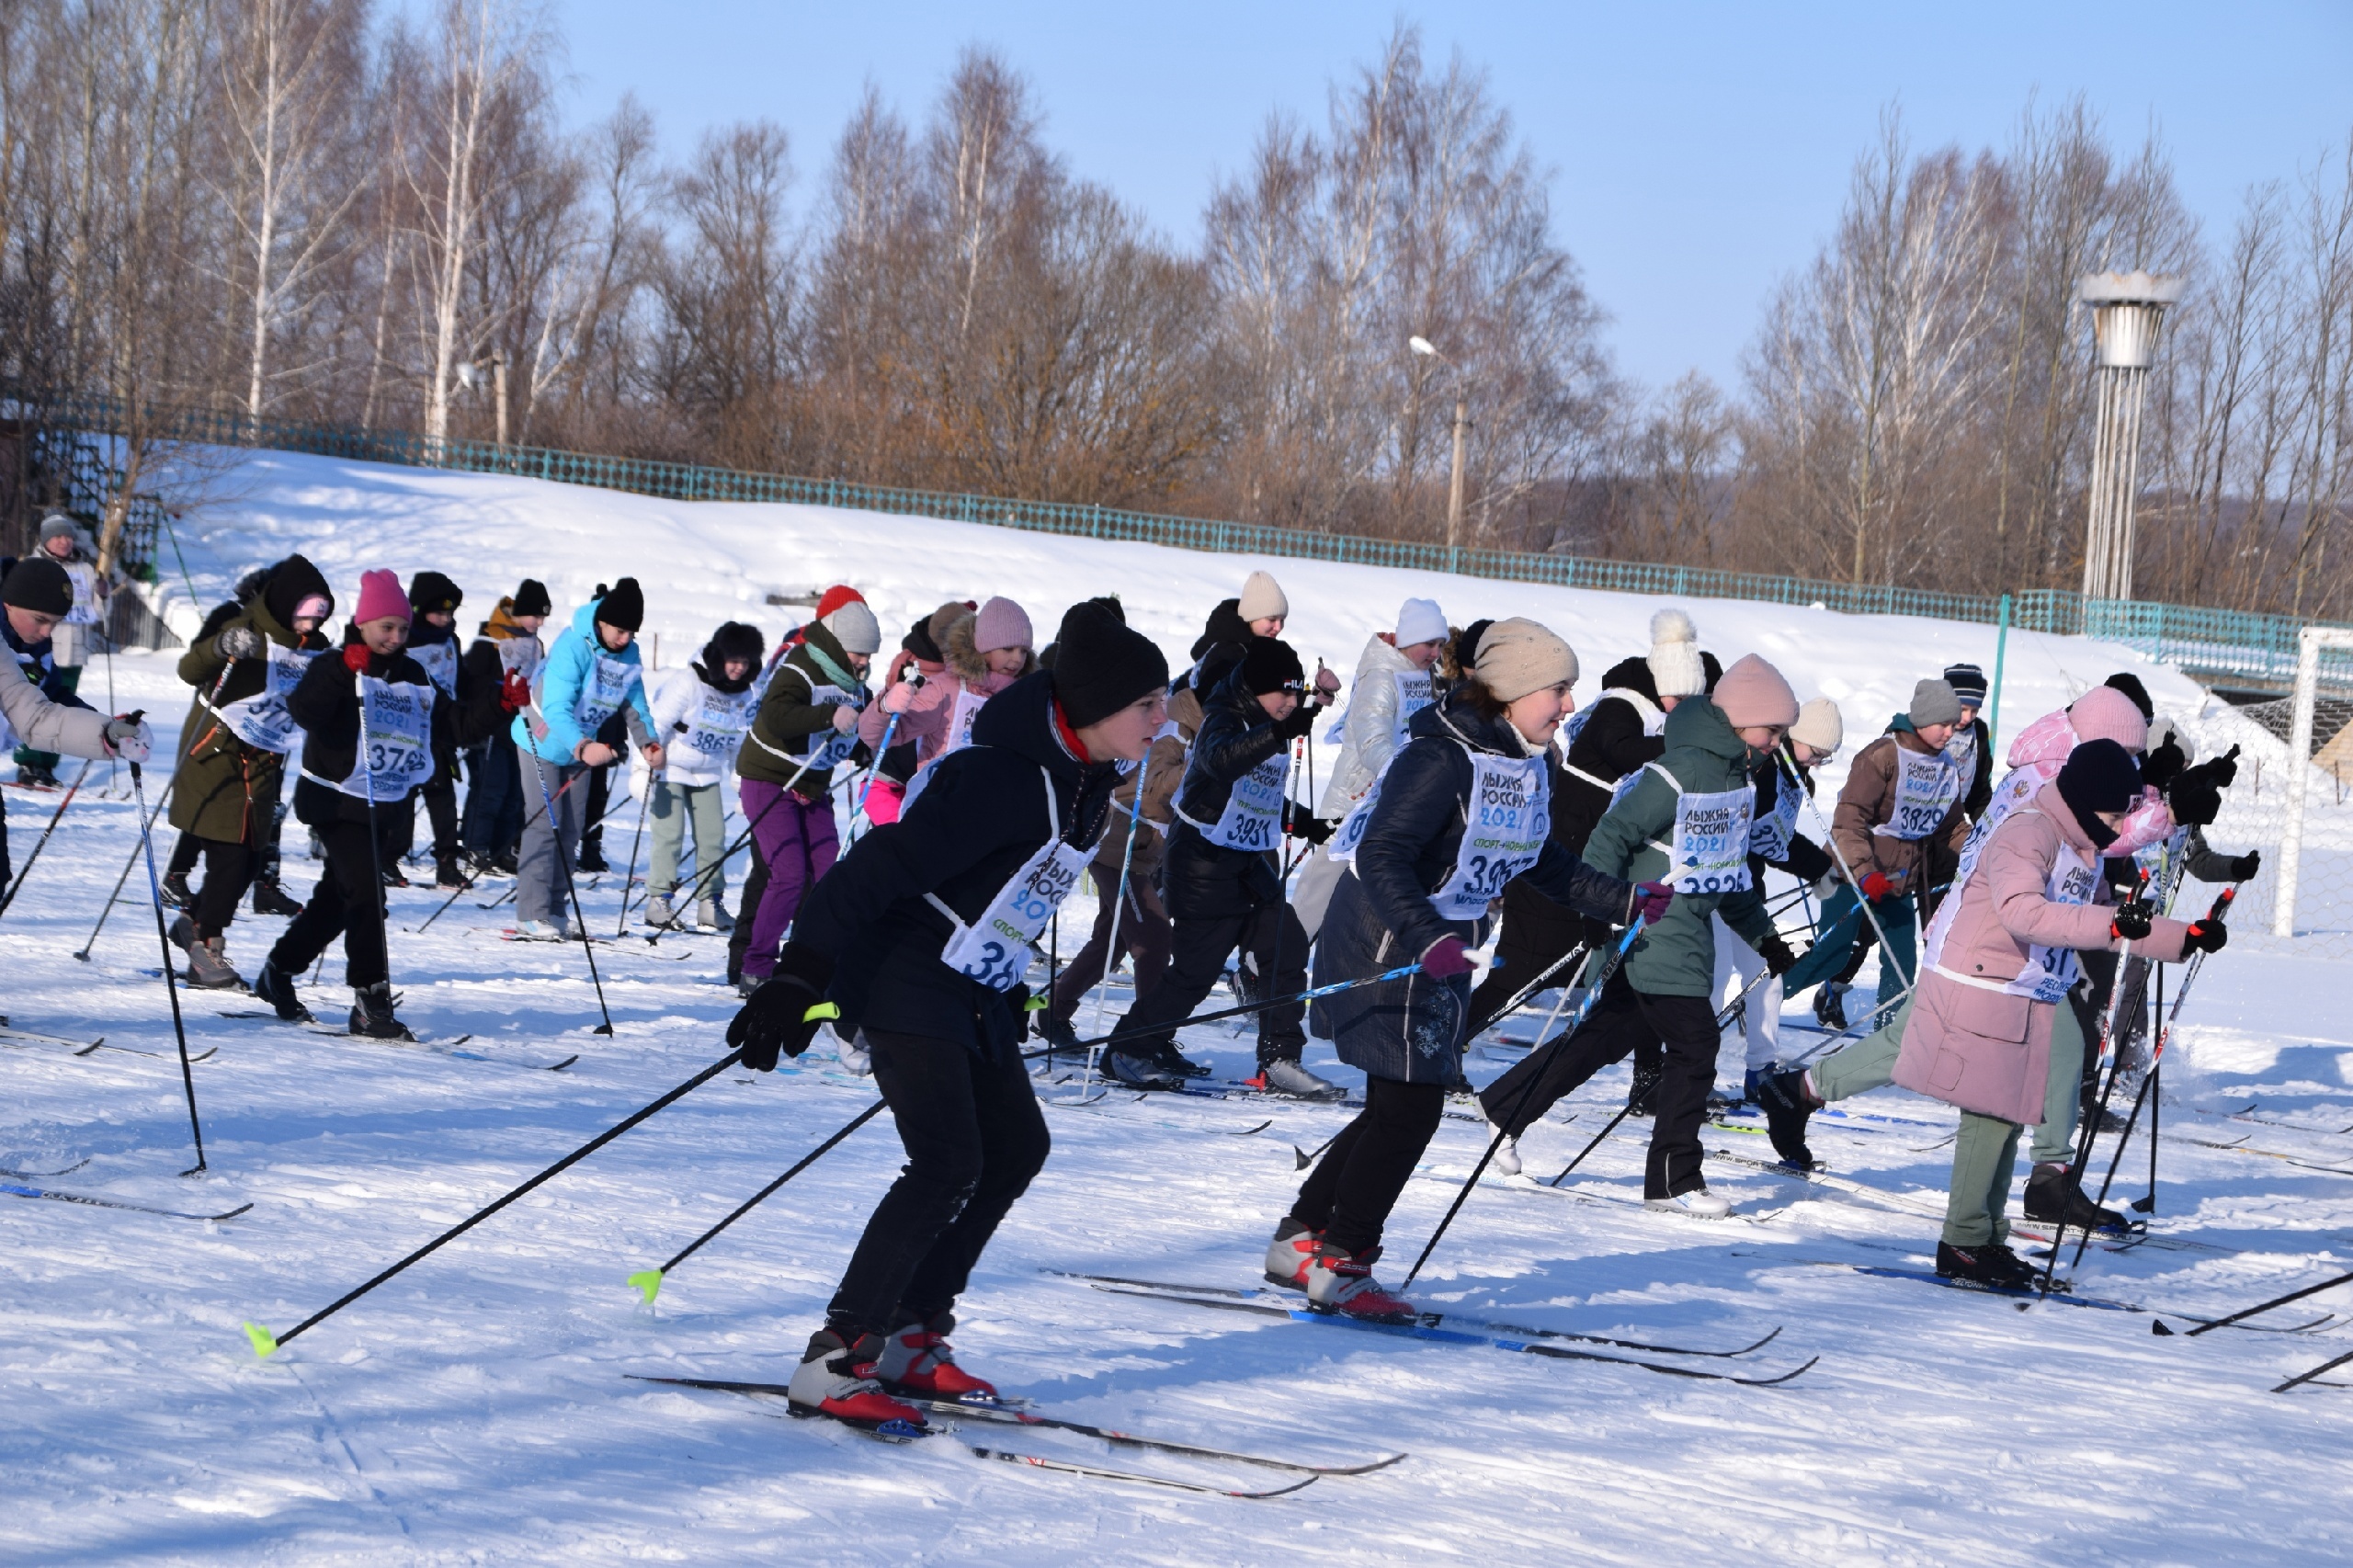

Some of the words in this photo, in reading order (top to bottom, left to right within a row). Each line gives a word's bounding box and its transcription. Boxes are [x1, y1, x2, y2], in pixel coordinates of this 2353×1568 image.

[1403, 680, 1432, 691] ЛЫЖНЯ
[374, 709, 411, 729] 2021
[867, 747, 886, 788] NORDWAY
[1136, 761, 1149, 801] NORDWAY
[1243, 780, 1272, 801] 2021
[1482, 772, 1524, 792] ЛЫЖНЯ
[1905, 778, 1934, 793] 2021
[1481, 790, 1528, 809] РОССИИ
[1481, 807, 1523, 830] 2021
[1684, 808, 1729, 823] ЛЫЖНЯ
[1900, 805, 1945, 833] 3829
[1684, 821, 1729, 835] РОССИИ
[1473, 837, 1501, 849] СПОРТ
[1683, 835, 1726, 852] 2021
[993, 918, 1026, 944] СПОРТ
[1541, 953, 1573, 982] NORDWAY
[1712, 1152, 1812, 1180] WWW.SPORT-MOTOR.RU
